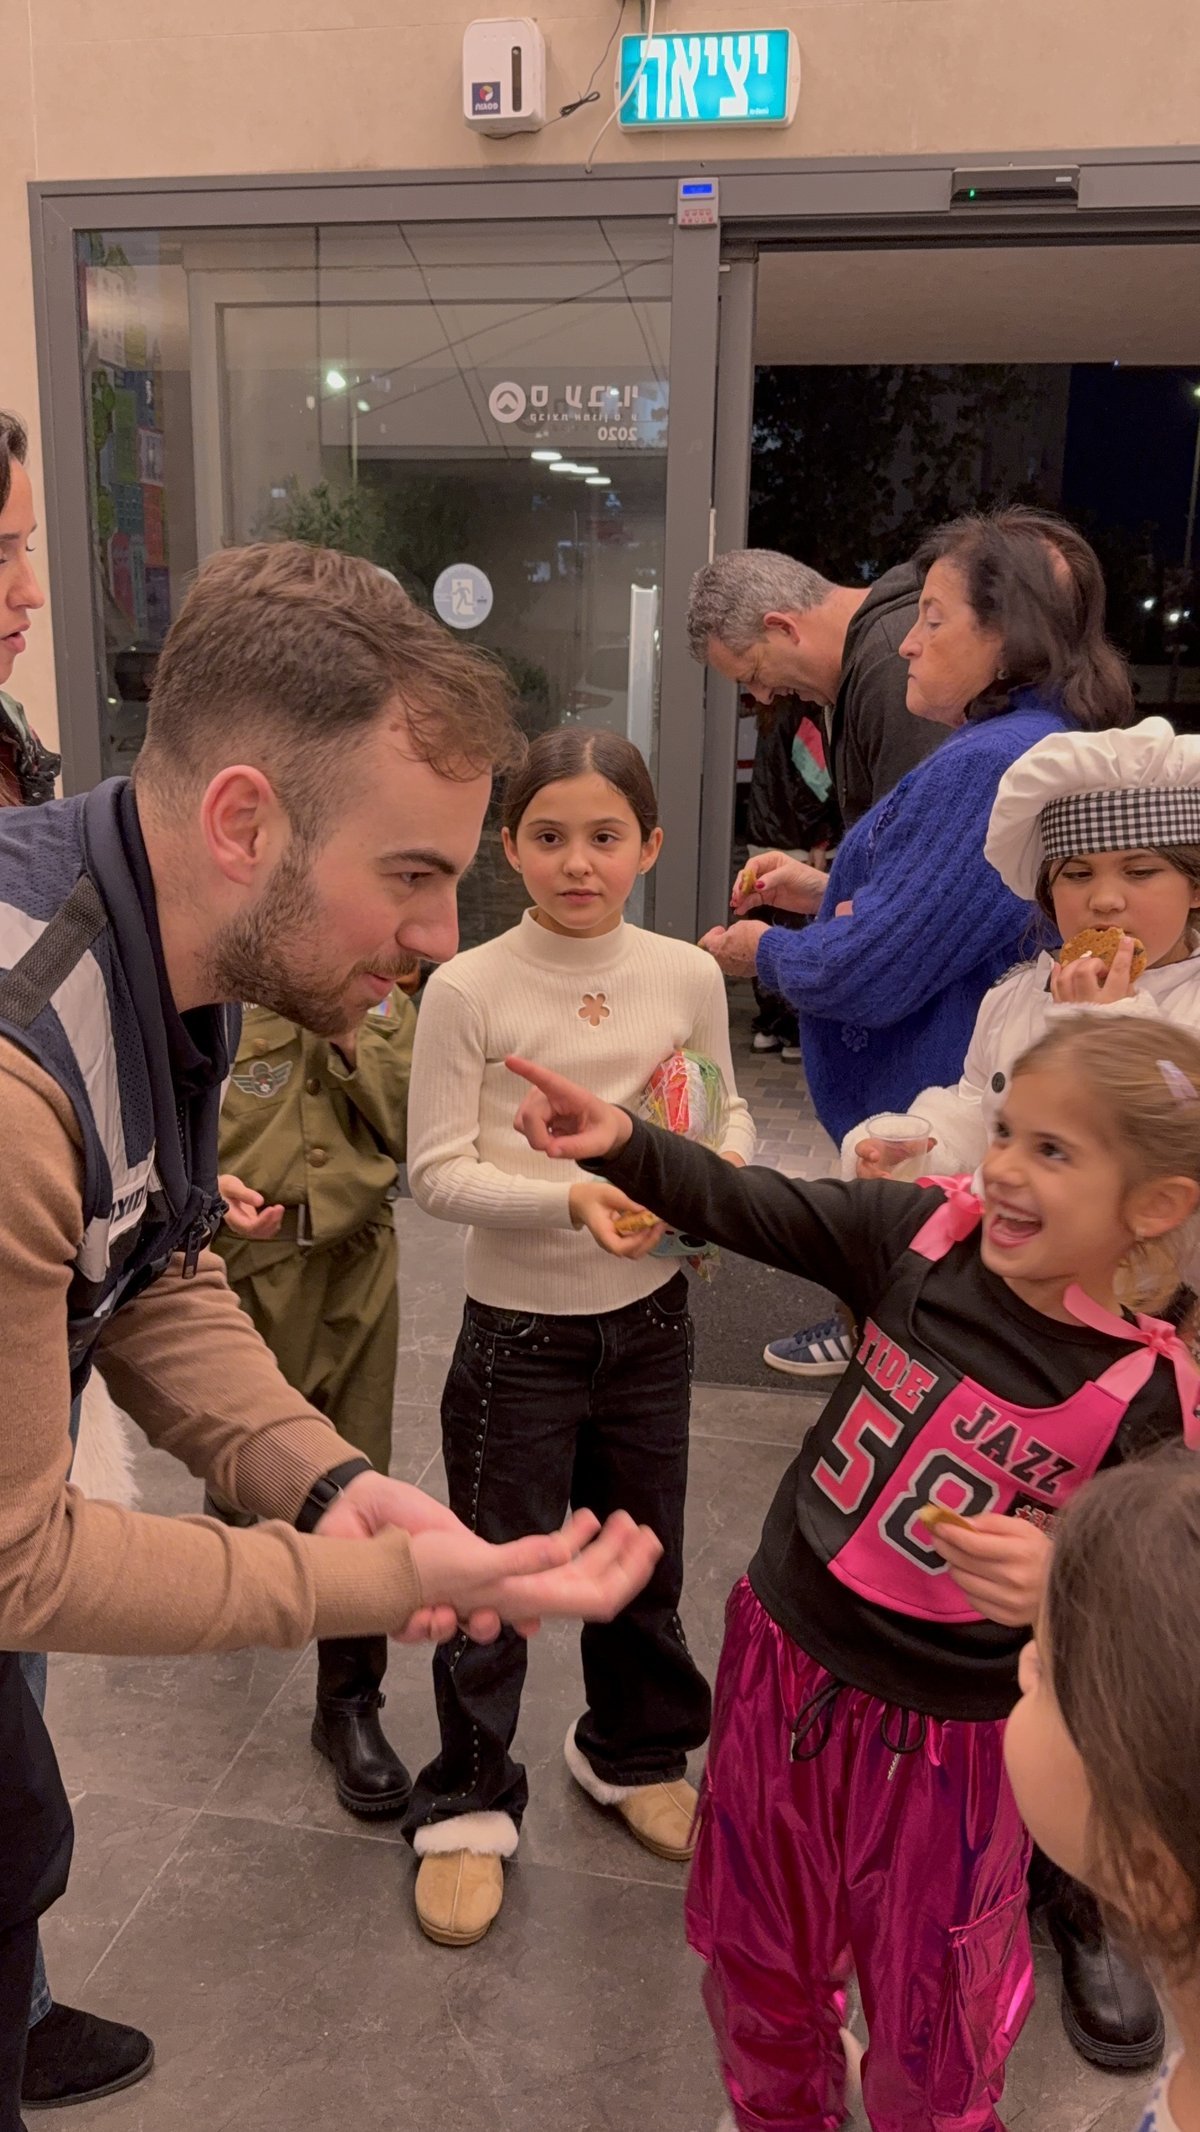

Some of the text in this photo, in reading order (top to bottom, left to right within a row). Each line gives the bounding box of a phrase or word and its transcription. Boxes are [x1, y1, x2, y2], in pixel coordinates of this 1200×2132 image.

[637, 34, 768, 119] יציאה
[855, 1316, 939, 1414] TIDE
[950, 1401, 1081, 1498] JAZZ
